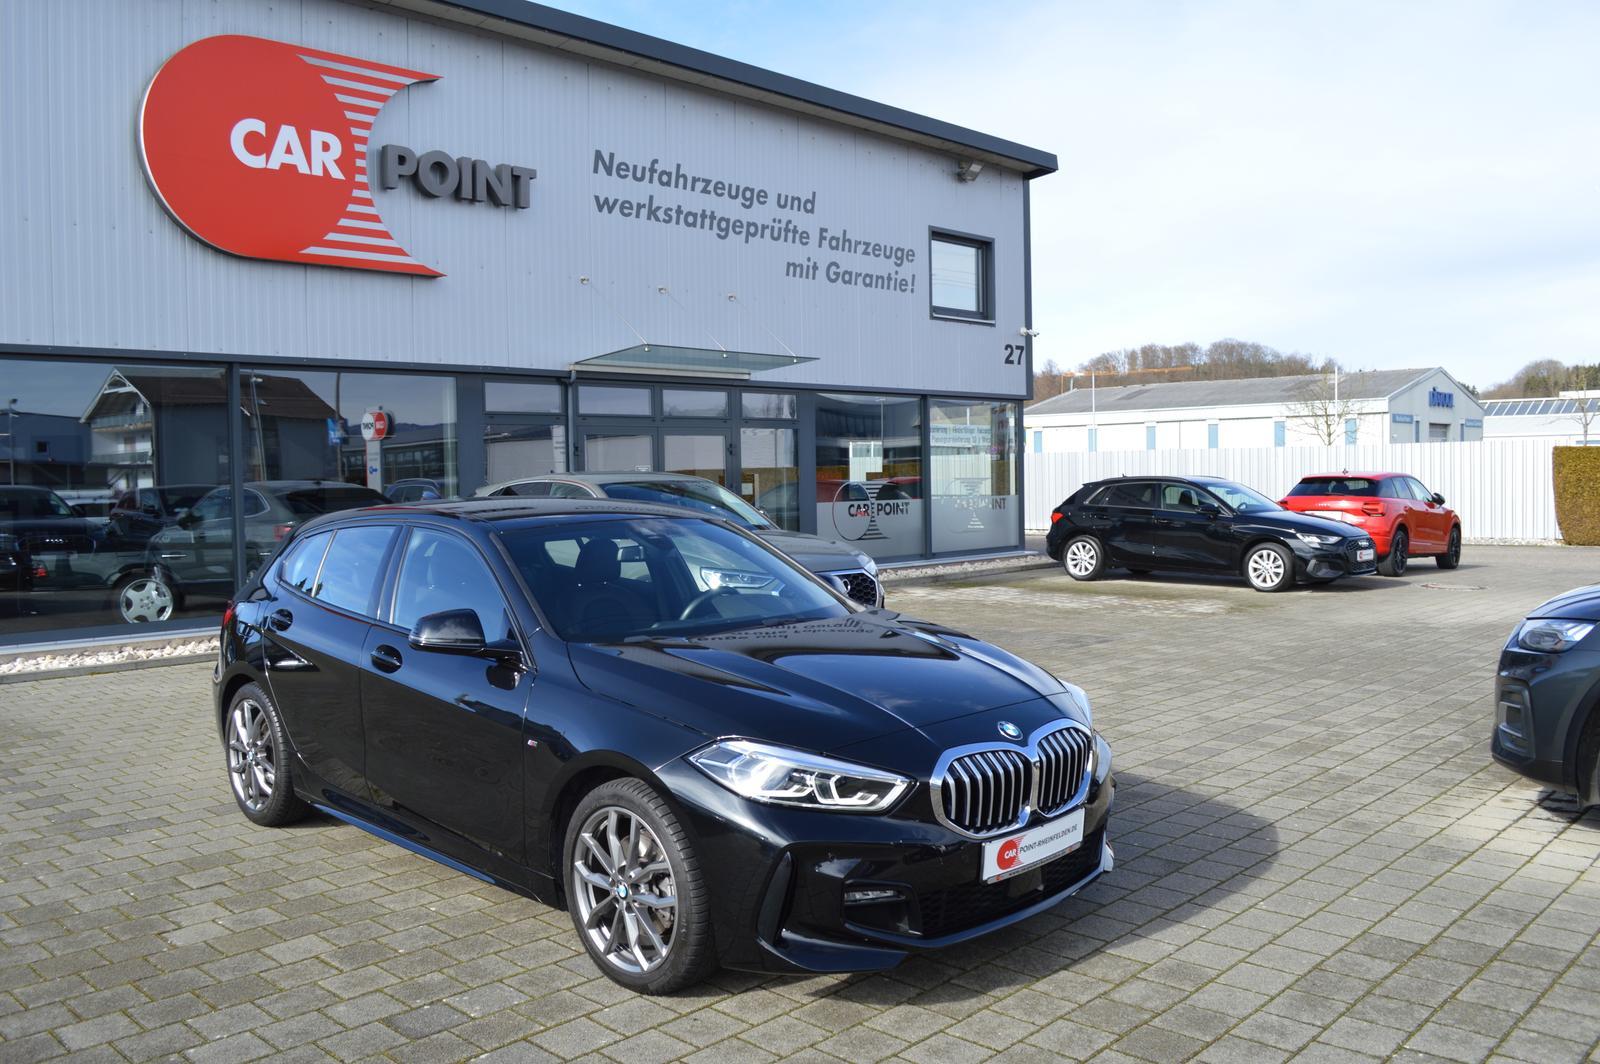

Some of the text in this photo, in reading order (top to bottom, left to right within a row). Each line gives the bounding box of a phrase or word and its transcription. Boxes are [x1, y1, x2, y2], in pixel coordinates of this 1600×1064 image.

[230, 118, 537, 209] CAR POINT
[592, 150, 816, 215] Neufahrzeuge und
[593, 194, 916, 267] werkstattgeprüfte Fahrzeuge
[785, 256, 916, 294] mit Garantie!
[1004, 343, 1025, 366] 27
[847, 501, 910, 518] CAR POINT
[1004, 848, 1017, 859] CAR
